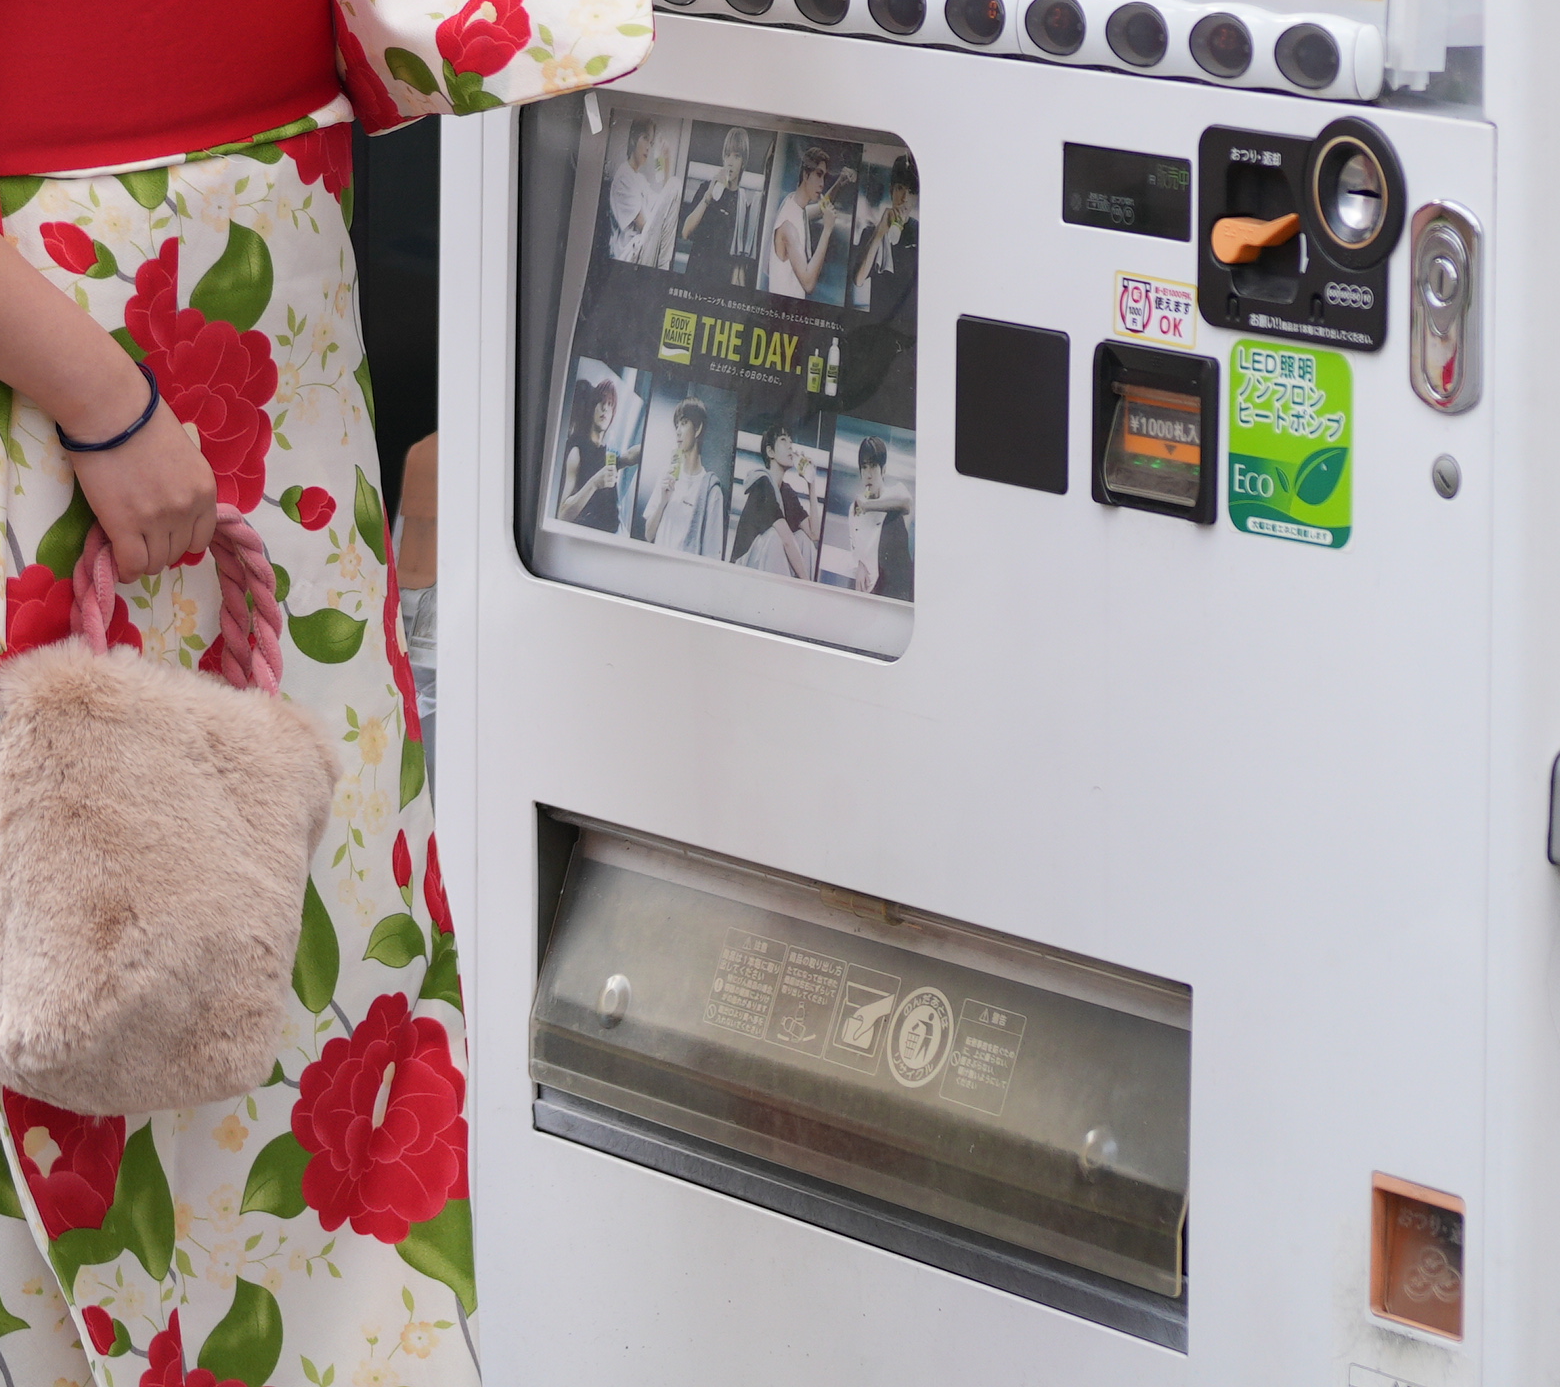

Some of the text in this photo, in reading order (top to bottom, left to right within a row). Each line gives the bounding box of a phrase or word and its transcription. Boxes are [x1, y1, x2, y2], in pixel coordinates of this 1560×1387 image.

[1231, 147, 1282, 166] おつり・返却
[1129, 306, 1143, 316] 1000
[1155, 297, 1192, 314] 使えます
[670, 317, 690, 332] BODY
[1159, 315, 1183, 338] OK
[700, 316, 802, 375] THE DAY.
[1239, 348, 1314, 382] LED照明
[1239, 377, 1325, 408] ノンフロン
[1238, 401, 1345, 438] ヒートポンプ
[754, 940, 769, 953] 注意
[720, 959, 765, 981] 出してください
[788, 951, 843, 977] 商品の取り出し方
[903, 992, 950, 1030] のんだあとは
[991, 1011, 1008, 1027] 警告
[893, 1052, 934, 1080] リサイクル
